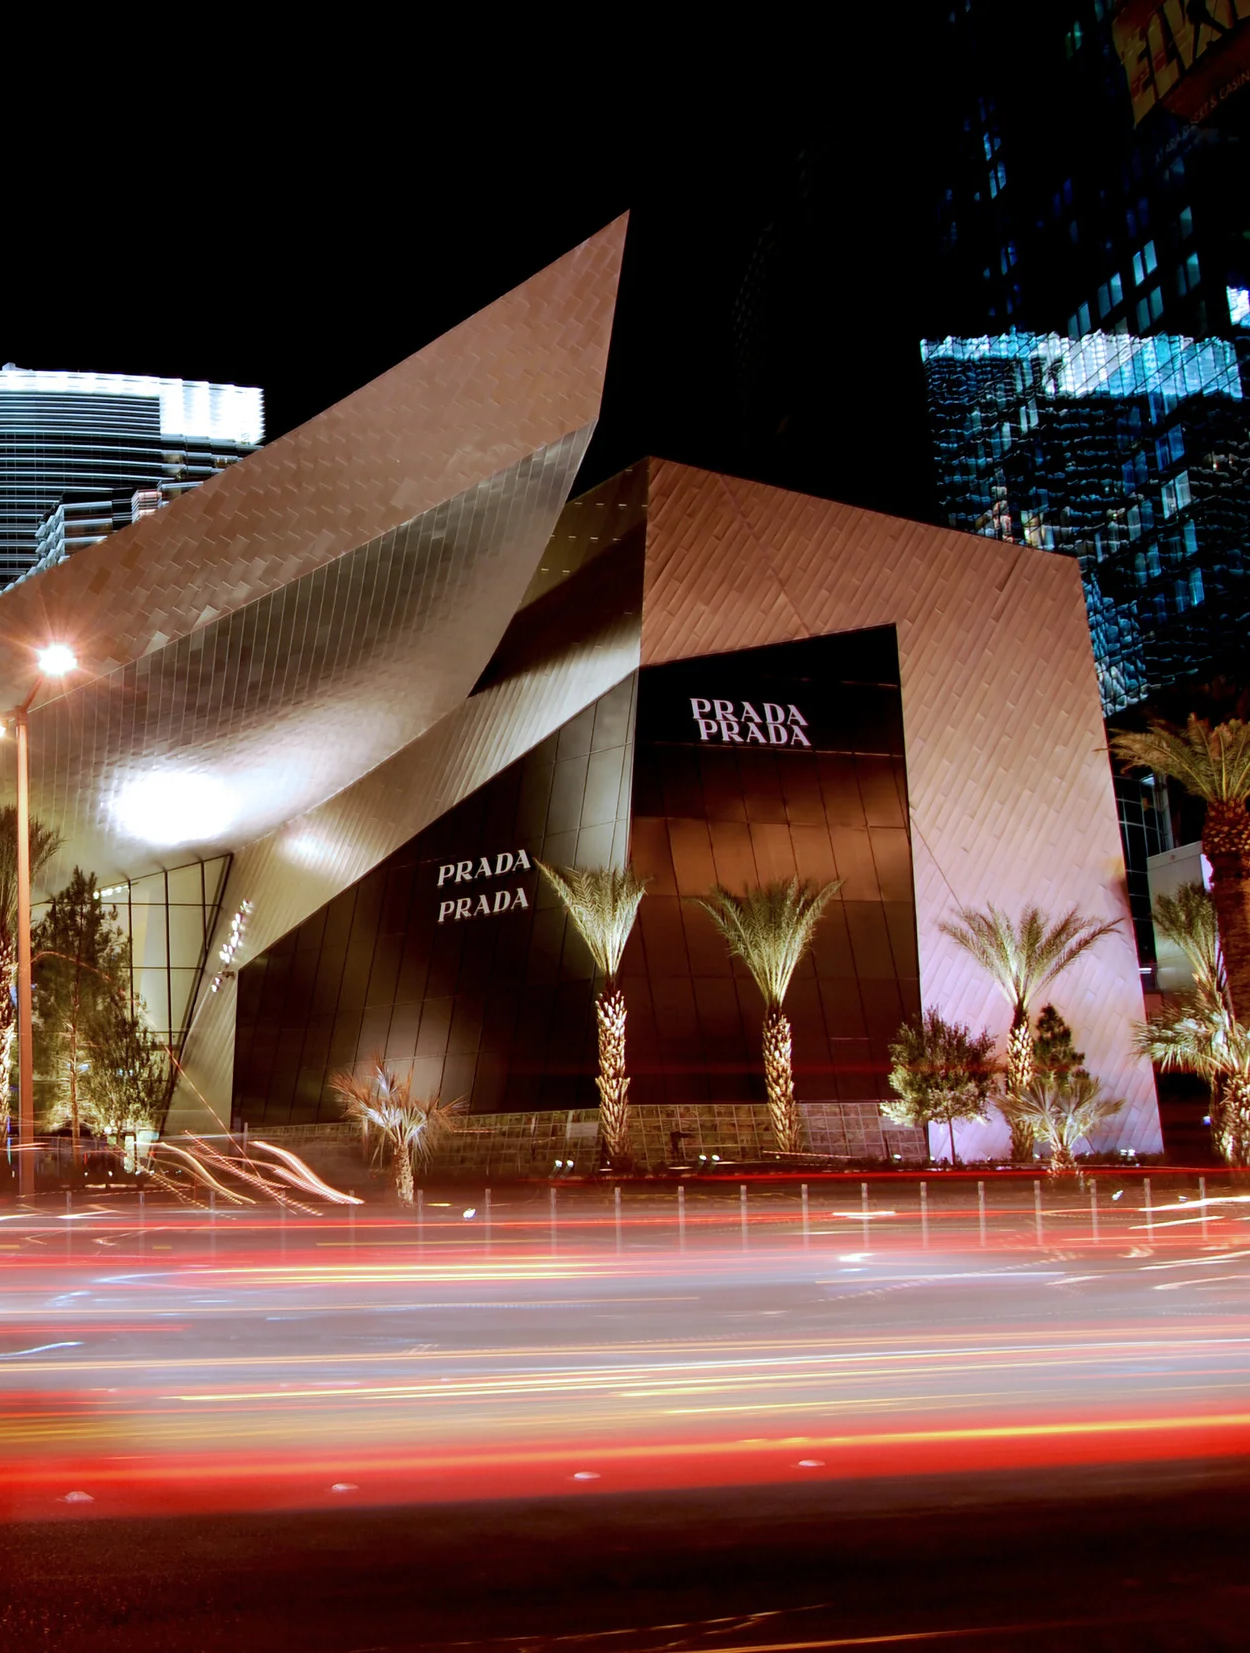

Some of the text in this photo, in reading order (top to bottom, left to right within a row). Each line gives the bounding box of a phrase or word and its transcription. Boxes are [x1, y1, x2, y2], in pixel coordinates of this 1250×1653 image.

[690, 697, 809, 726] PRADA
[697, 719, 811, 746] PRADA
[437, 849, 531, 887] PRADA
[437, 887, 529, 924] PRADA
